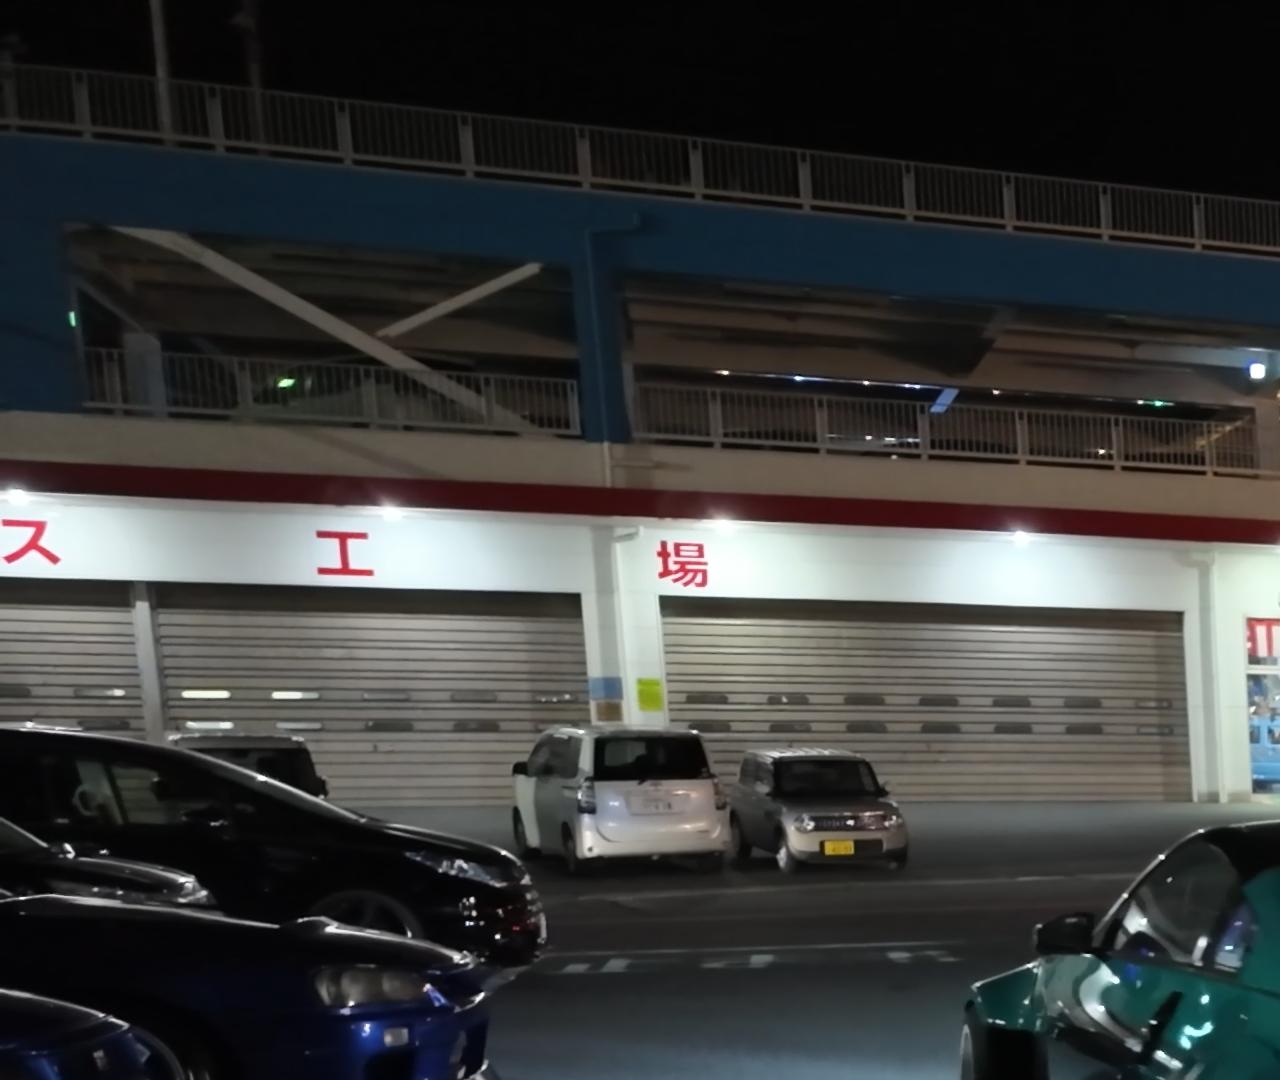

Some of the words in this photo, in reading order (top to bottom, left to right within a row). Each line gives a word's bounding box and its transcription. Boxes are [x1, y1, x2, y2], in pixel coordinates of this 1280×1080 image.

[2, 518, 61, 565] ス
[315, 530, 375, 577] 工
[656, 540, 709, 588] 場
